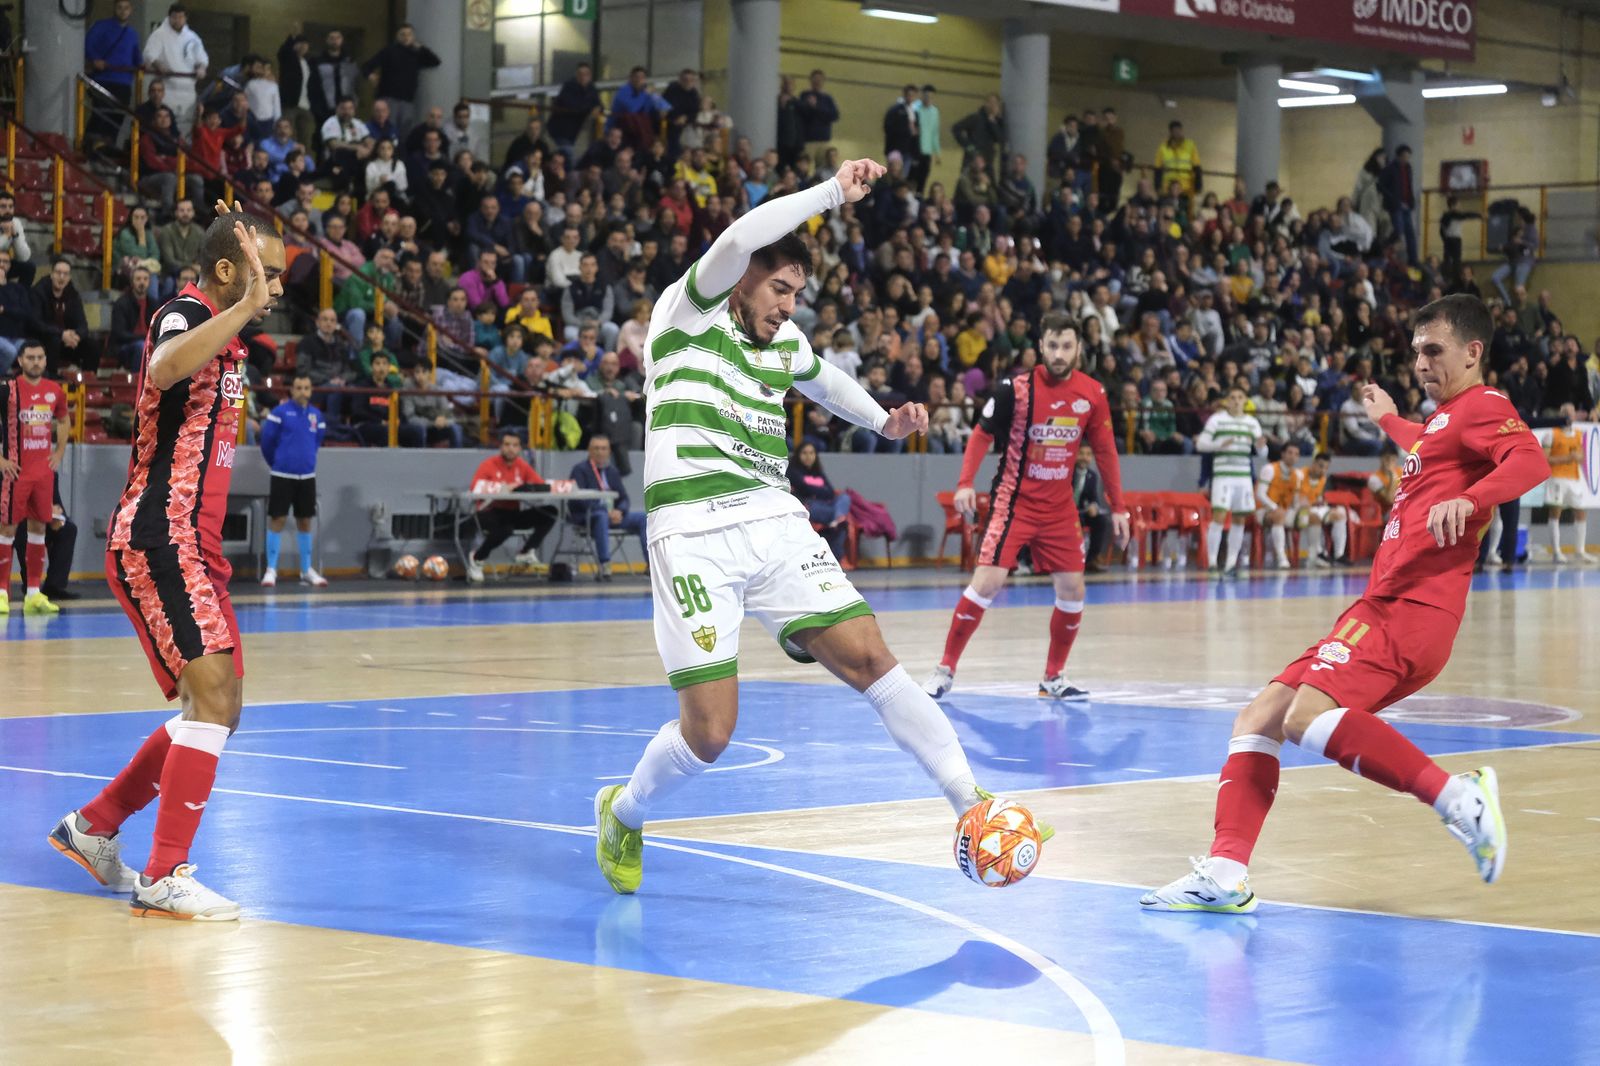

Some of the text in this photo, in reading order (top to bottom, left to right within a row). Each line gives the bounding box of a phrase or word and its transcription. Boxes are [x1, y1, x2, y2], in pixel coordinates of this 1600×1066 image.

[1382, 0, 1473, 34] IMDECO
[801, 563, 810, 571] El
[672, 574, 713, 618] 98
[1334, 617, 1370, 647] 11
